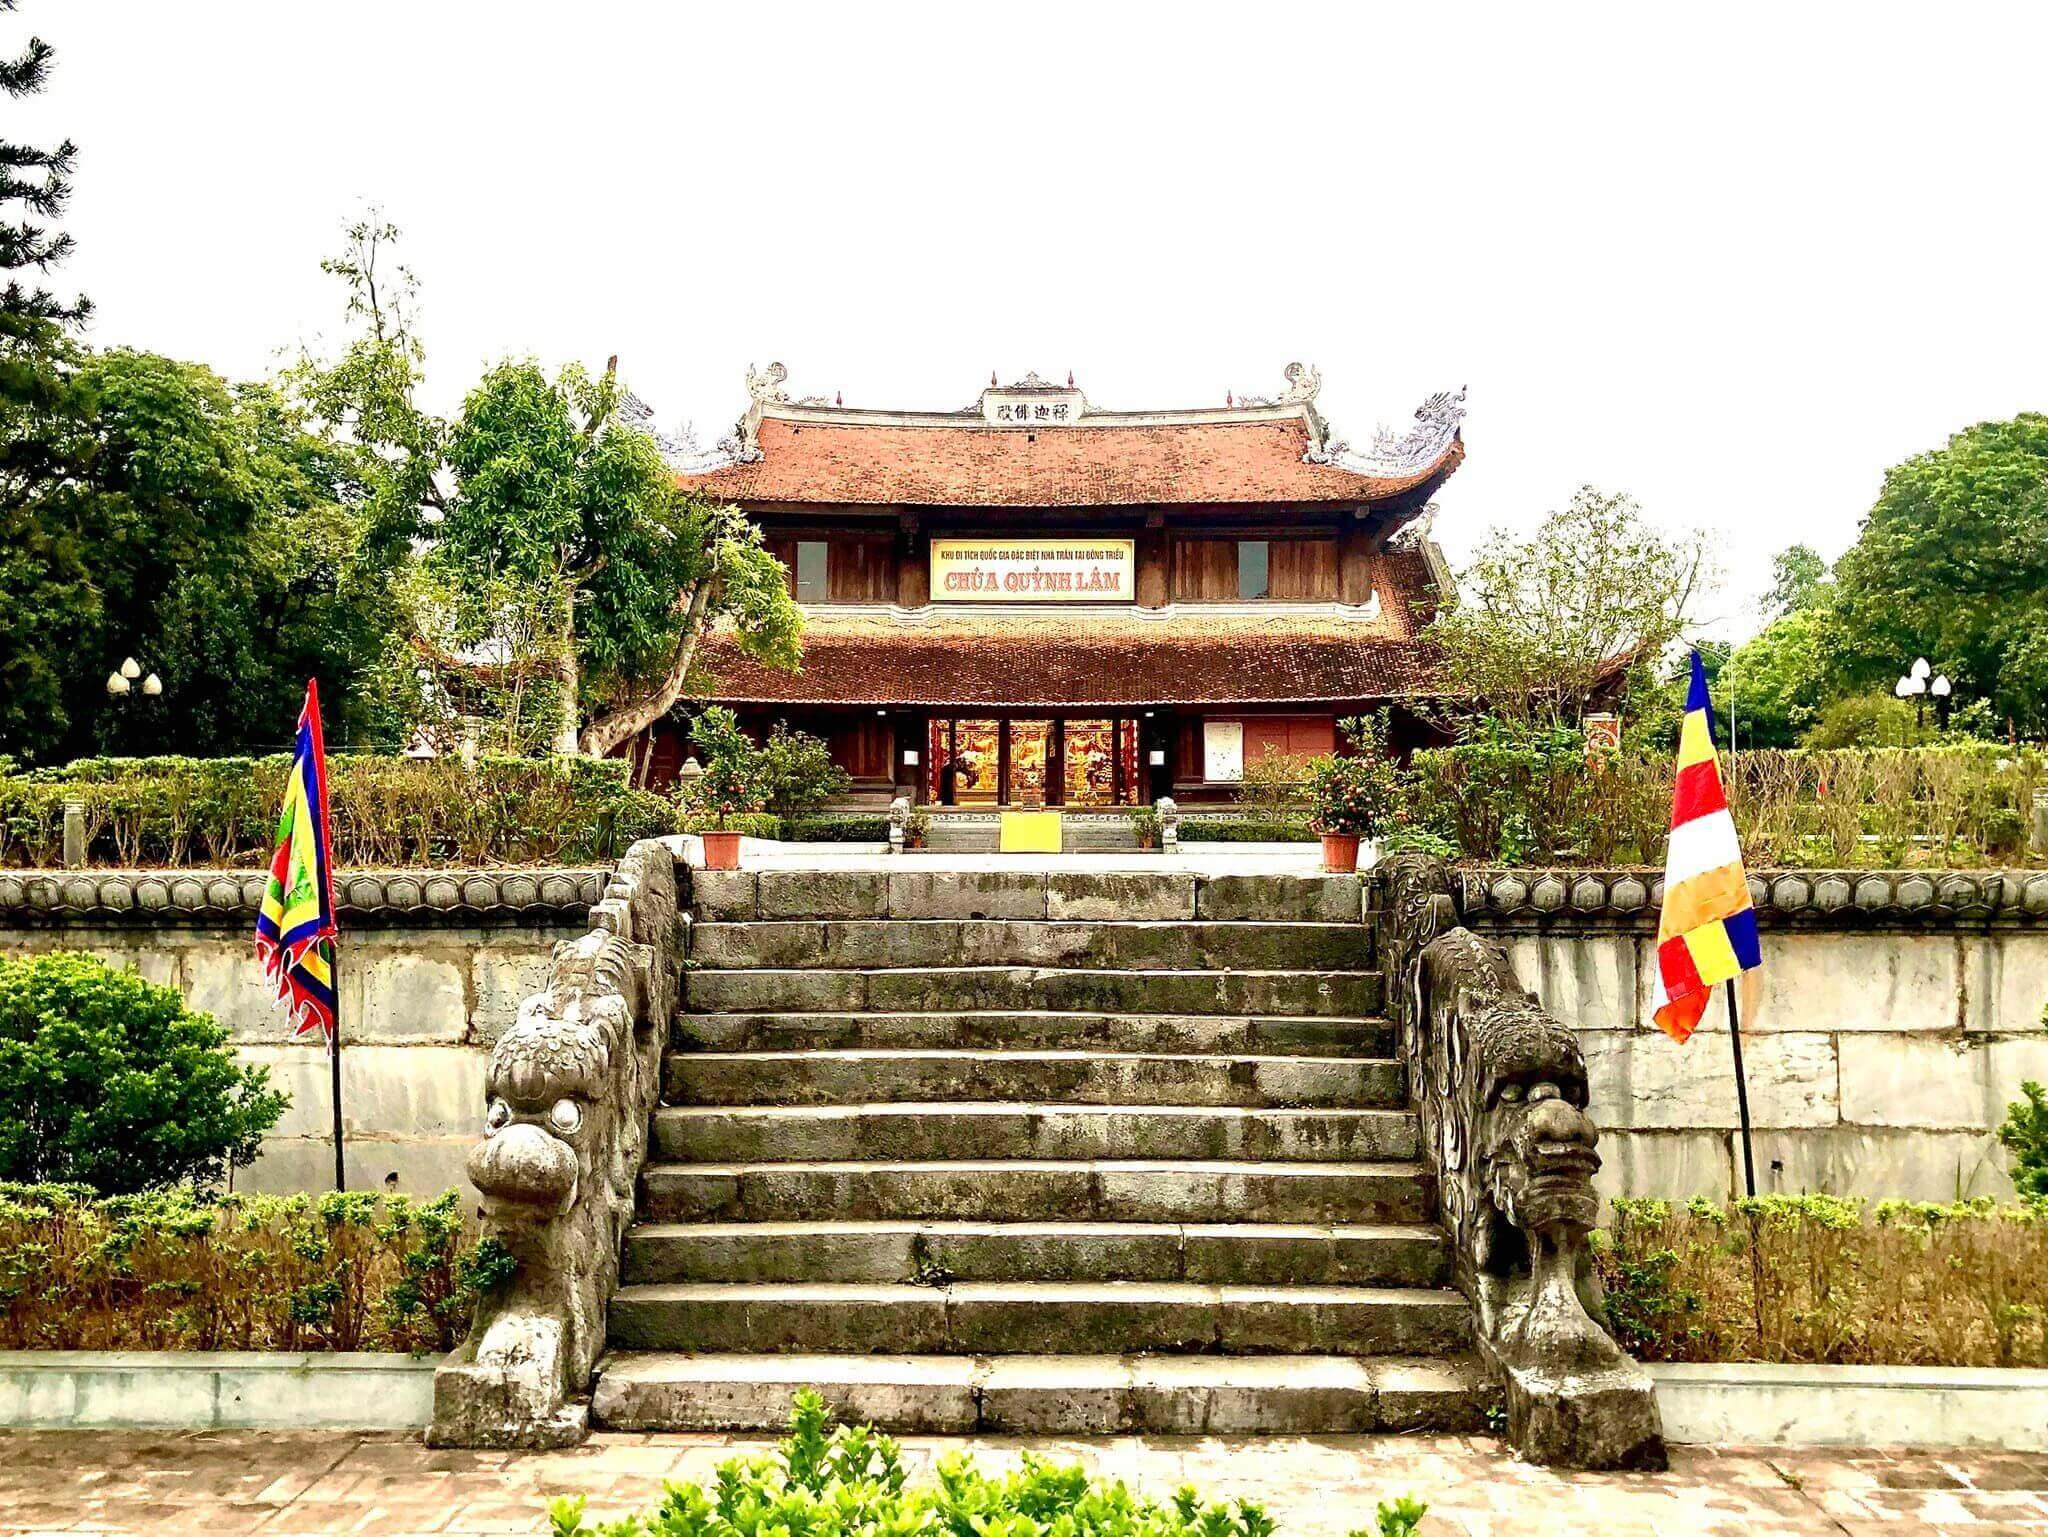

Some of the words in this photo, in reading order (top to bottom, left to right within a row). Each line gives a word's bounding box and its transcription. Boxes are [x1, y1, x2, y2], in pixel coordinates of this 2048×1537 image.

[941, 550, 954, 560] KHU
[956, 550, 963, 560] DI
[965, 549, 979, 560] TÍCH
[999, 550, 1010, 560] GIA
[1075, 566, 1121, 592] LÂM
